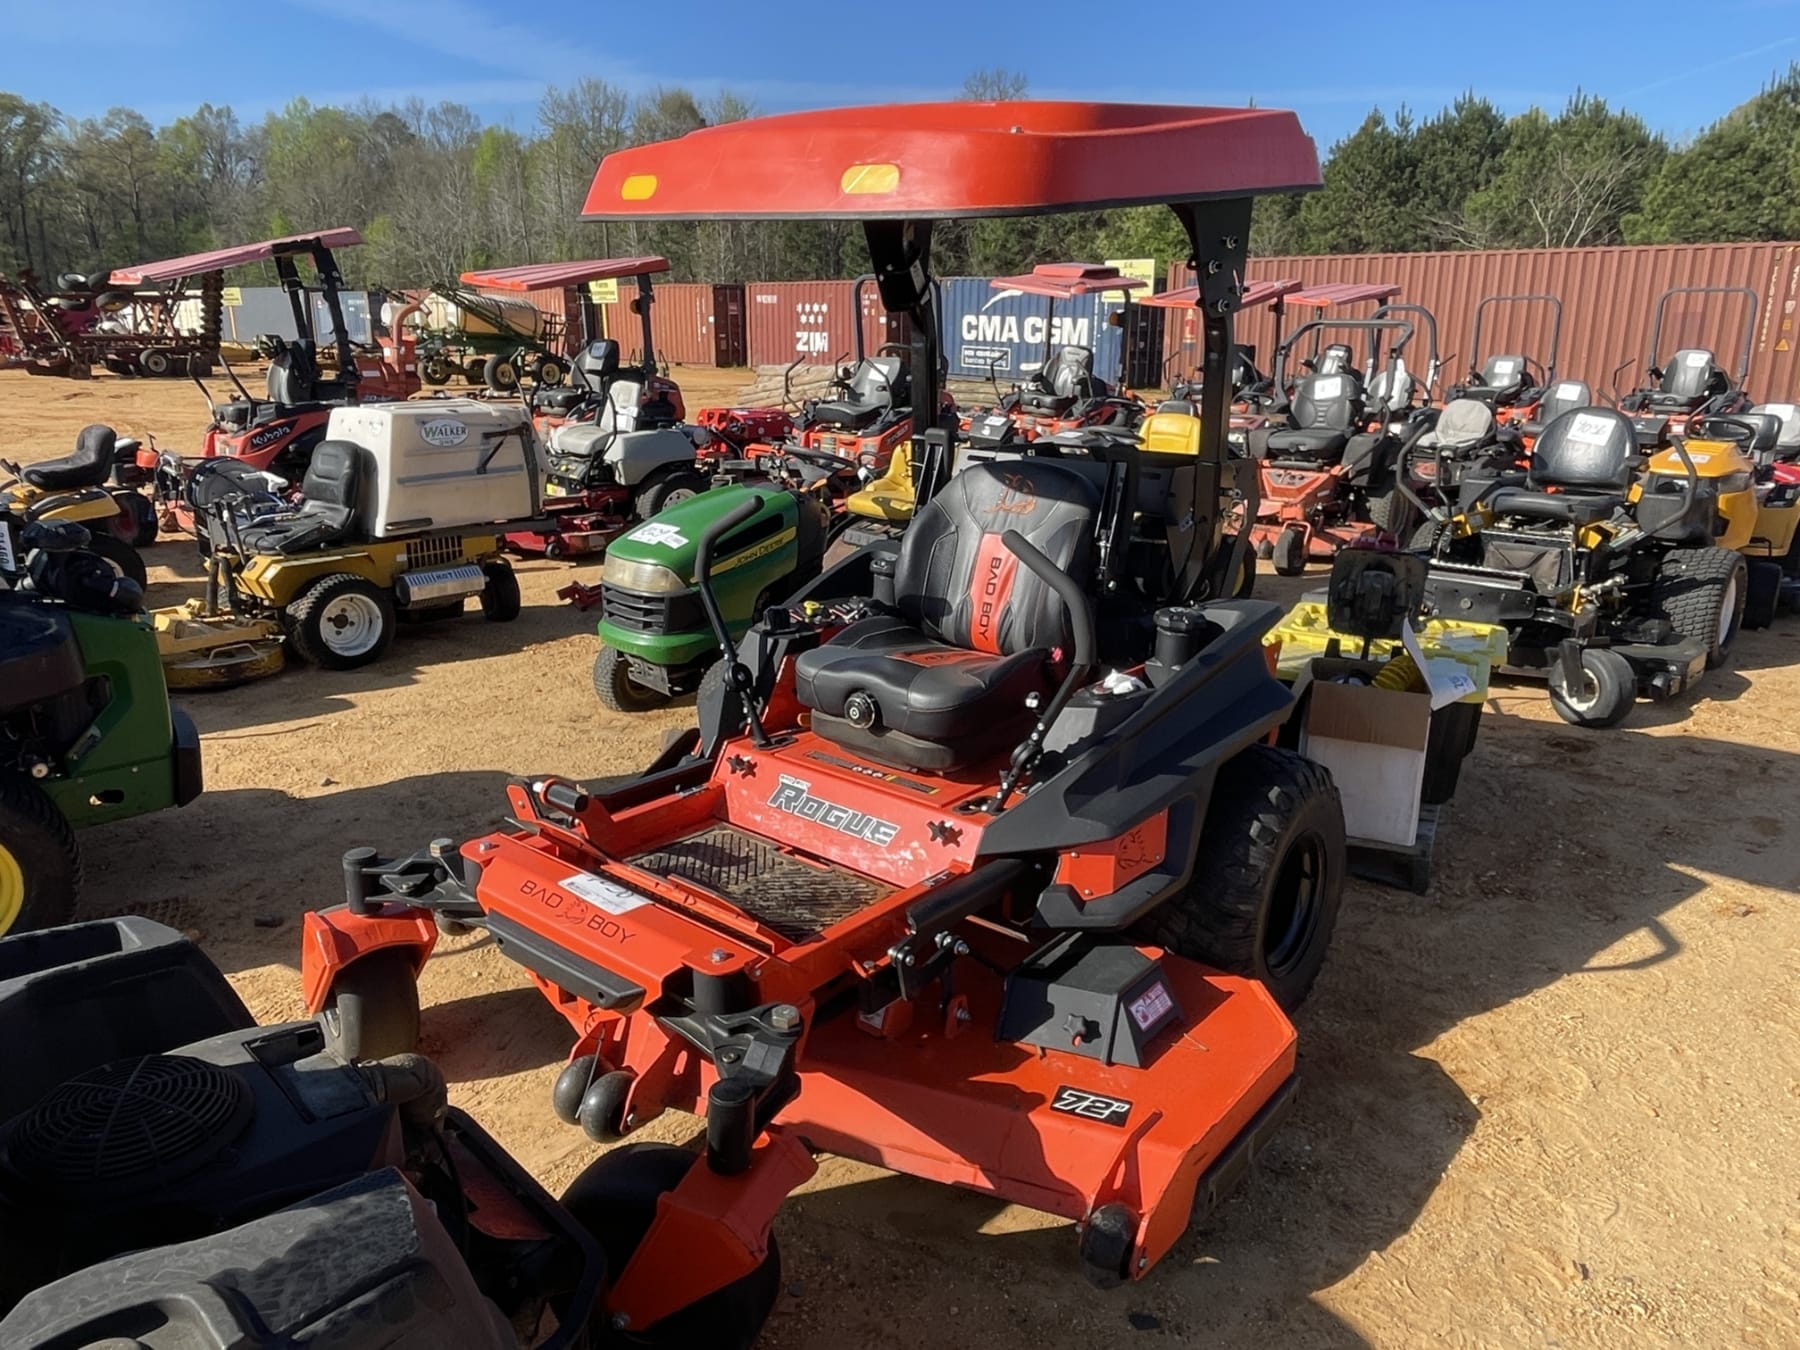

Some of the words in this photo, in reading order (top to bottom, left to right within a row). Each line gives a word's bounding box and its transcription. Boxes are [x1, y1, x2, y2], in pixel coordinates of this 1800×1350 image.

[795, 331, 828, 352] ZIM
[962, 314, 1020, 343] CMA
[1023, 316, 1089, 345] CGM
[252, 425, 291, 444] Kubota
[424, 425, 467, 438] WALKER
[735, 551, 758, 567] JOHN
[758, 538, 785, 557] DEERE
[984, 556, 1002, 596] BAD
[978, 601, 993, 641] BOY
[767, 779, 901, 847] ROGUE
[519, 879, 564, 909] BAD
[586, 913, 637, 944] BOY
